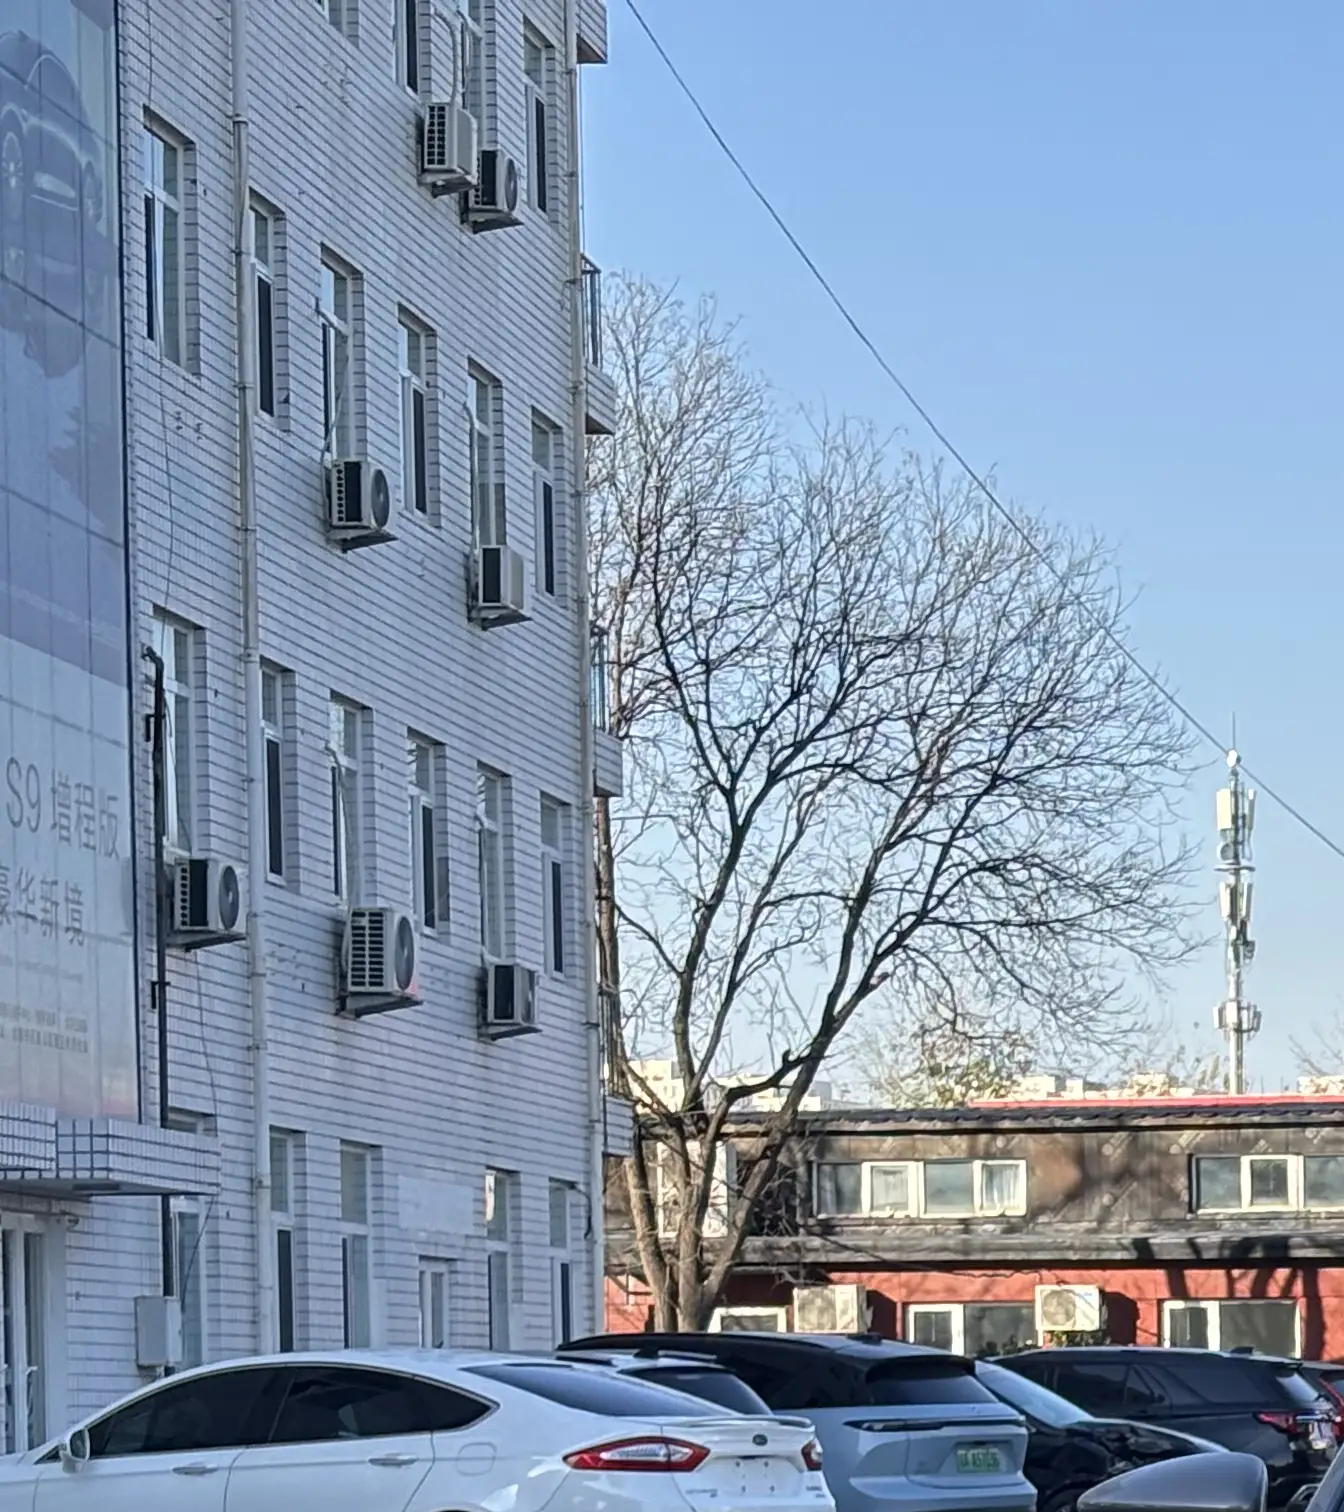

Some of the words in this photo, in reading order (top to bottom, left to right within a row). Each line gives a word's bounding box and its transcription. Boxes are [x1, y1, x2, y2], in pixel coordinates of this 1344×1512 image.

[6, 757, 42, 833] S9
[51, 768, 120, 861] 增程版
